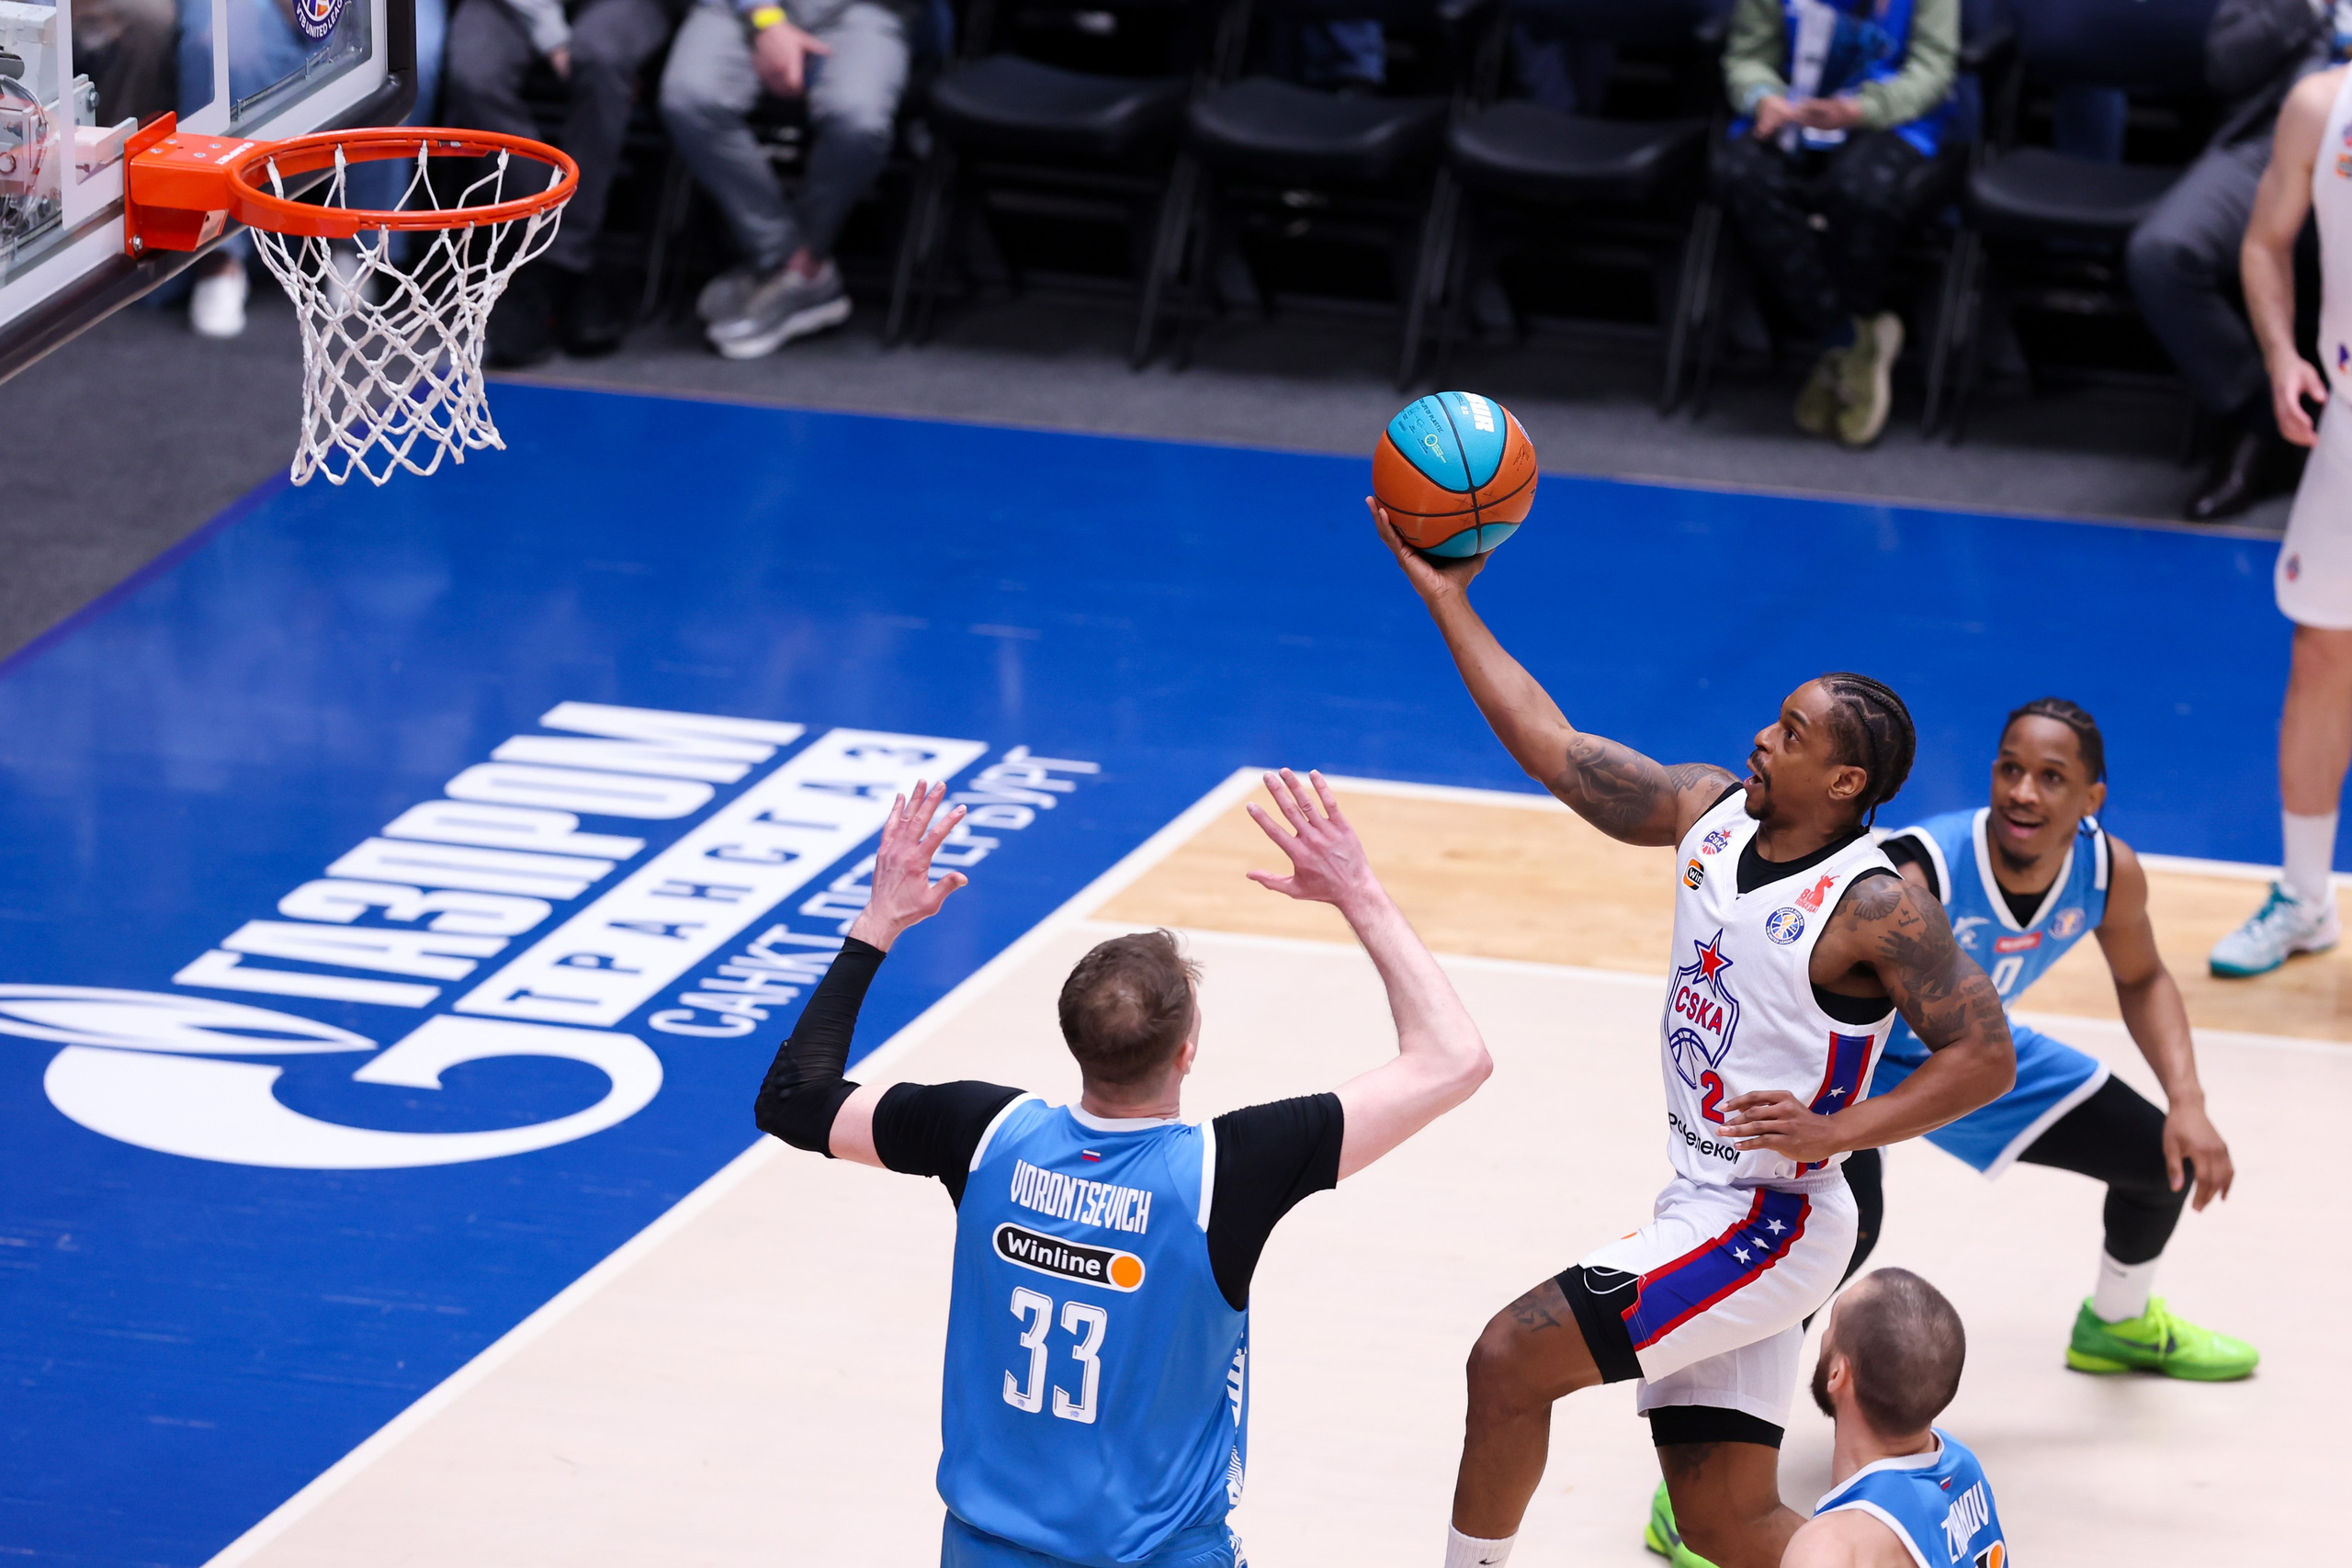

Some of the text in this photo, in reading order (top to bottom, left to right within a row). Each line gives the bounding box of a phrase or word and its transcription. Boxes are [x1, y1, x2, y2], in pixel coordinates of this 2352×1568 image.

[296, 2, 307, 28] VTB
[305, 21, 328, 38] UNITED
[1428, 413, 1443, 434] PLASTIC
[172, 700, 807, 1009] ГАЗПРОМ
[1709, 832, 1728, 851] CSKA
[502, 742, 940, 1008] ТРАНСГАЗ
[1689, 866, 1702, 885] Win
[1675, 986, 1723, 1036] CSKA
[1700, 1068, 1725, 1125] 2
[1011, 1158, 1152, 1235] VORONTSEVICH
[1007, 1231, 1102, 1277] Winline
[1002, 1286, 1108, 1425] 33
